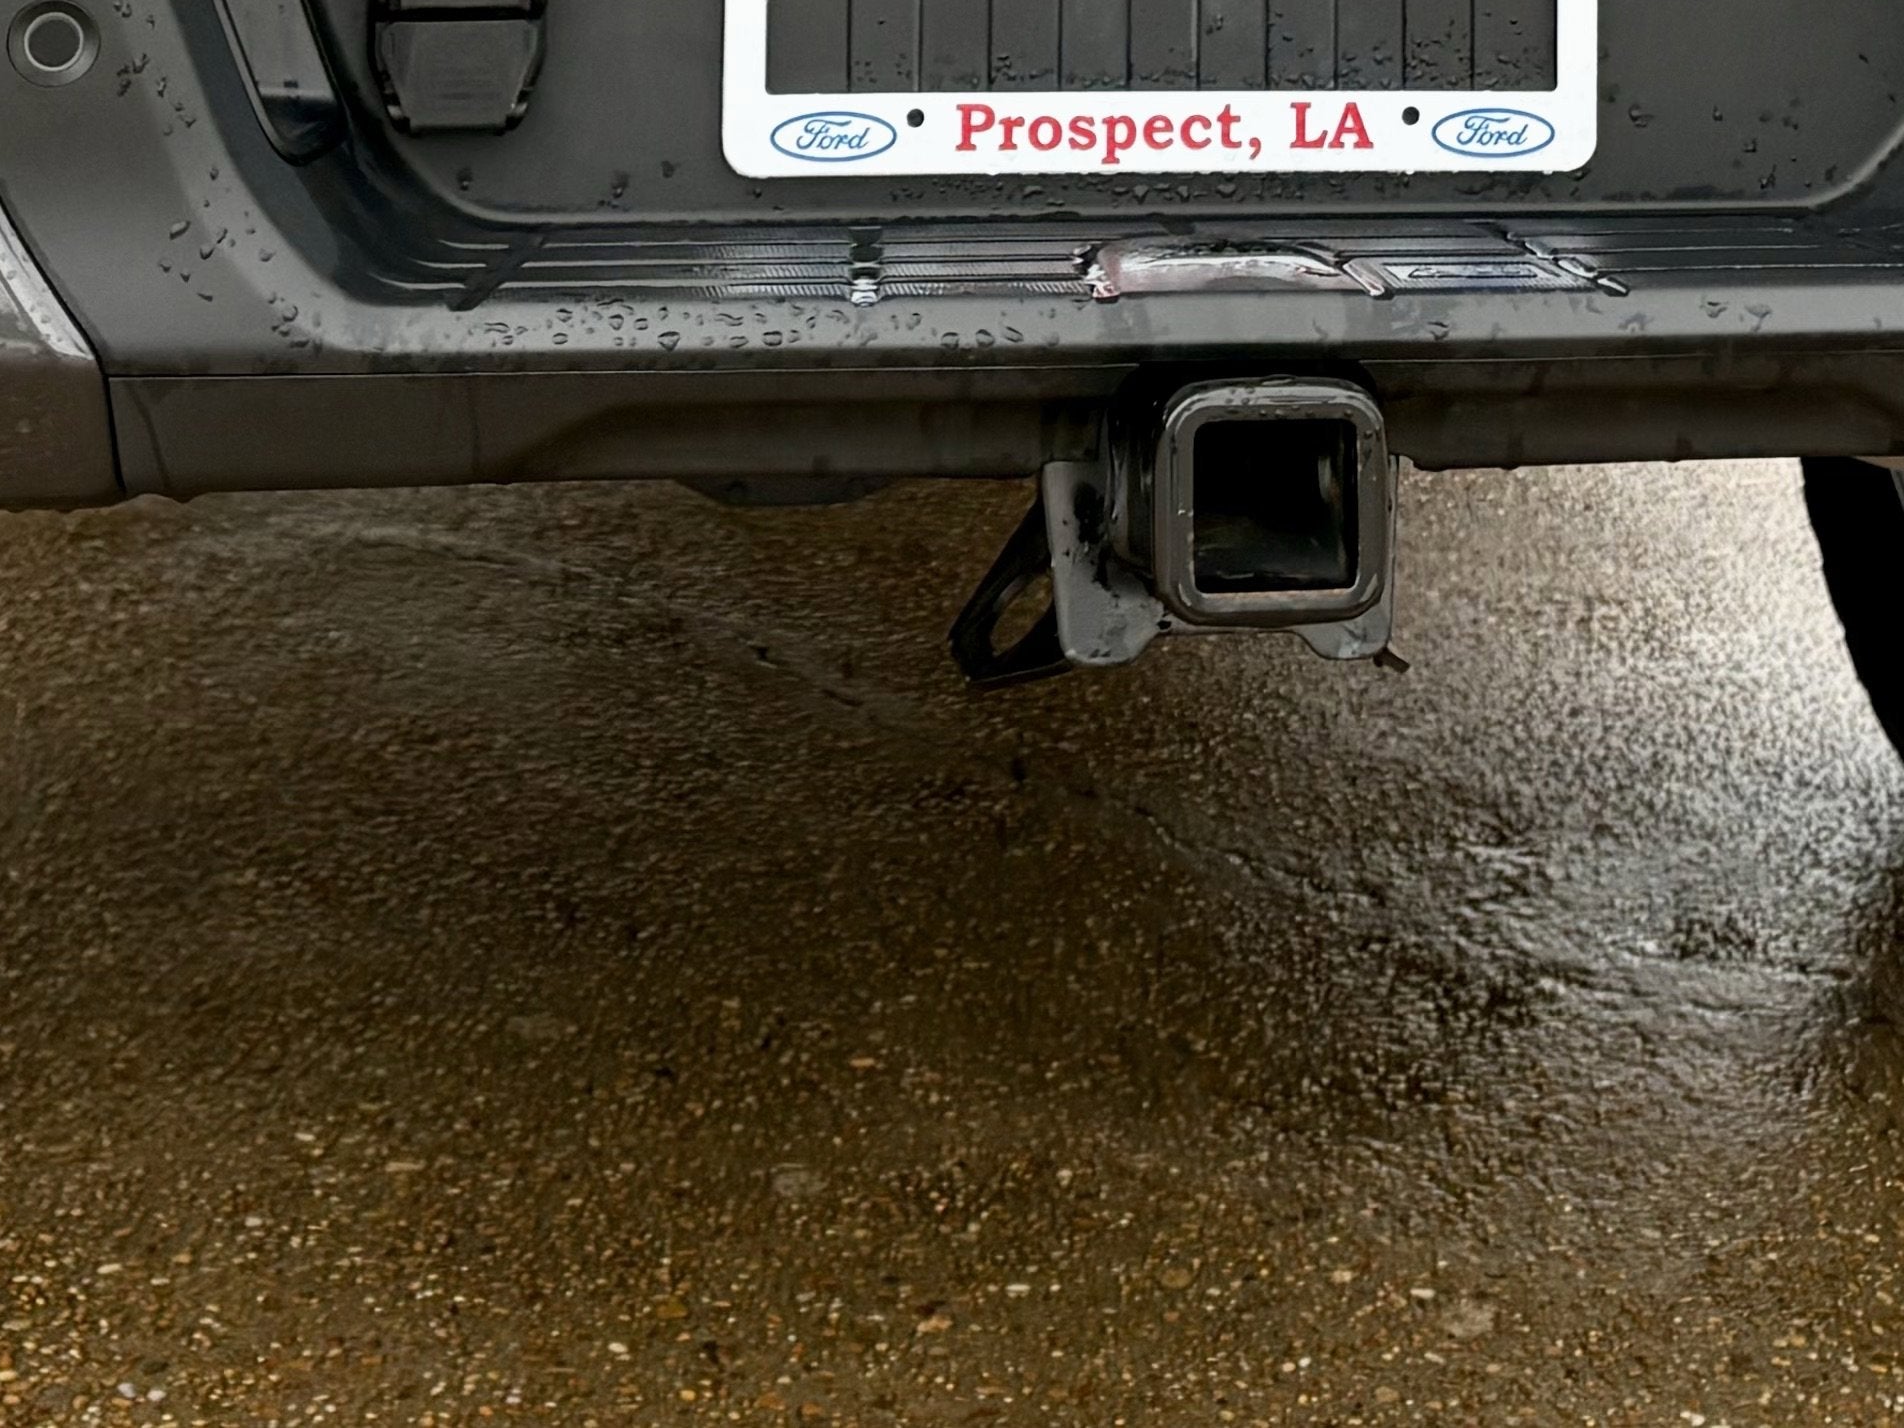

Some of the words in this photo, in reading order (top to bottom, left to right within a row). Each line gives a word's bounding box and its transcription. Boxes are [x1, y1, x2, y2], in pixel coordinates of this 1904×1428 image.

[796, 118, 871, 152] Ford
[956, 104, 1262, 163] Prospect,
[1290, 103, 1374, 149] LA
[1456, 116, 1532, 148] Ford
